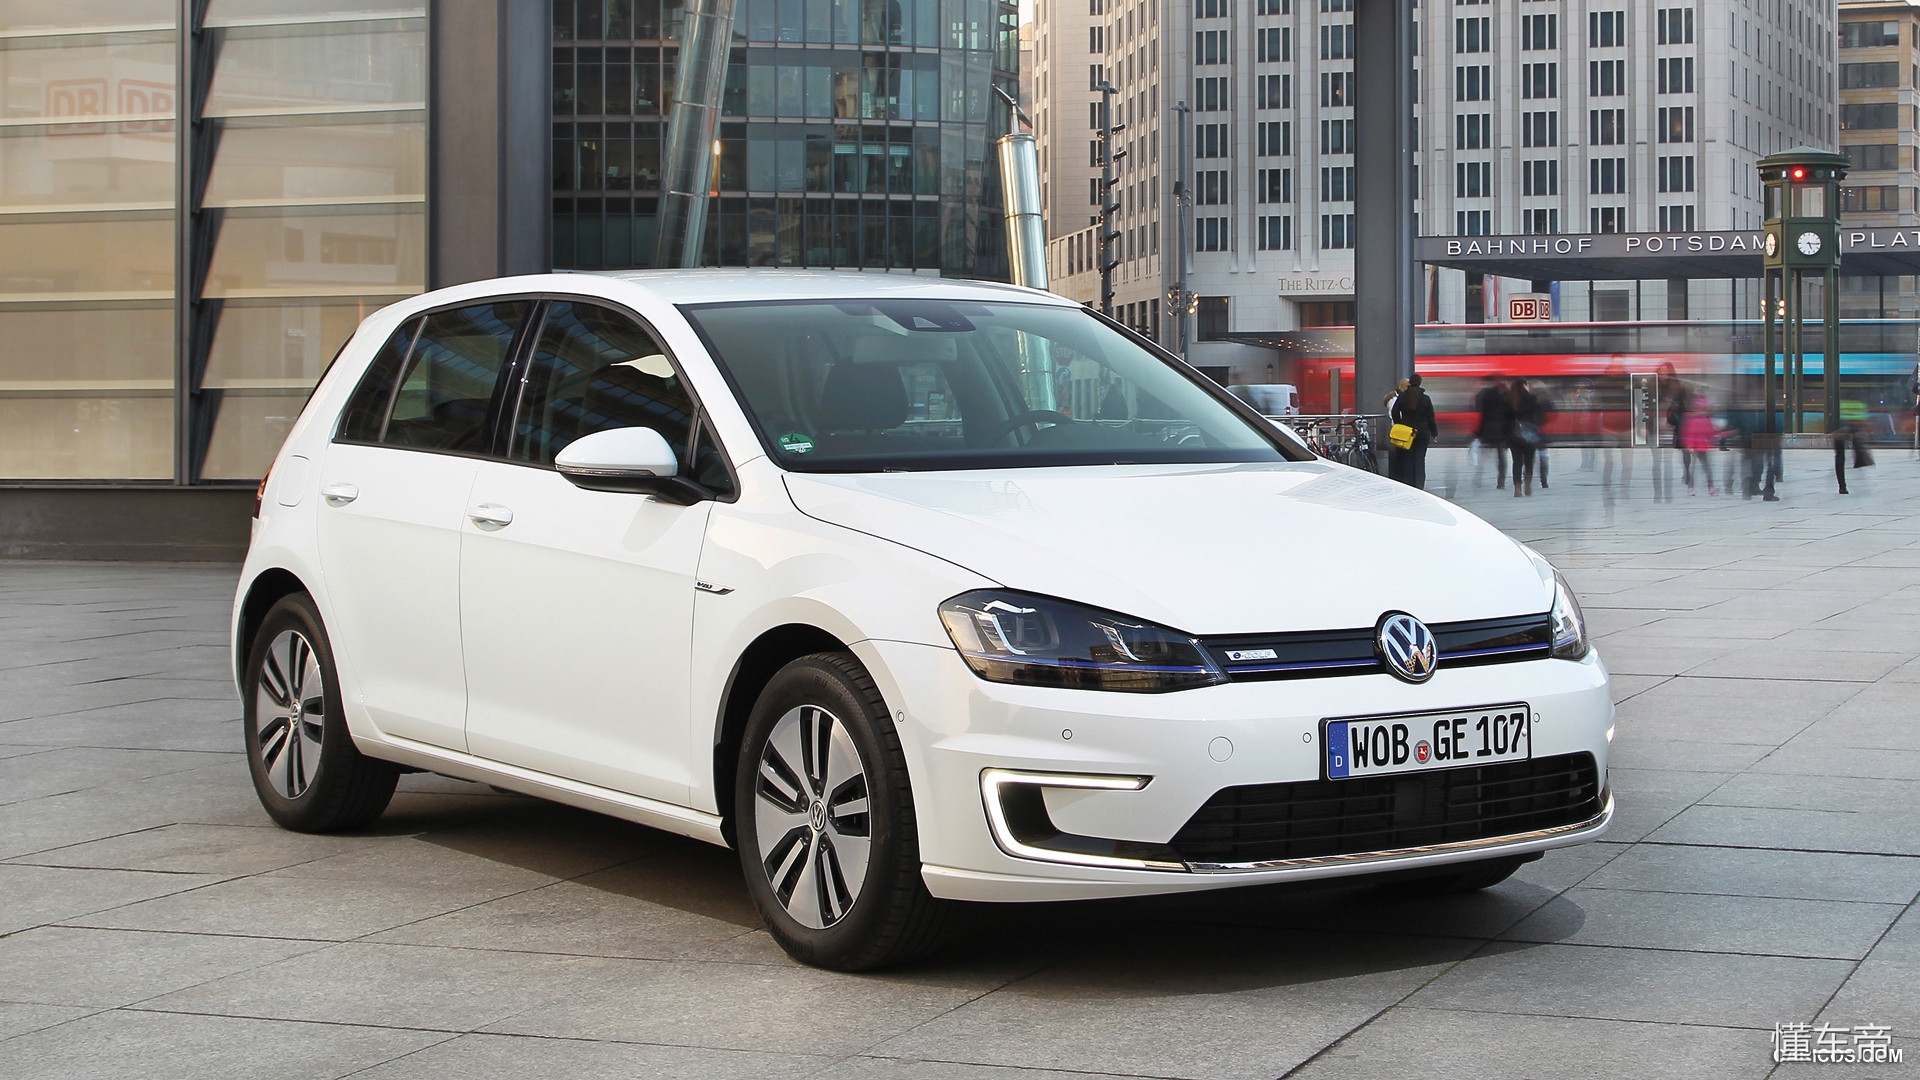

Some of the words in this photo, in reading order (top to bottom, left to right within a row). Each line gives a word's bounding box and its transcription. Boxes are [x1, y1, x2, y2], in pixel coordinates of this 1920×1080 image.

[53, 88, 99, 129] DB
[126, 89, 174, 131] DB
[1447, 238, 1592, 255] BAHNHOF
[1278, 278, 1302, 291] THE
[1513, 302, 1534, 317] DB
[1540, 302, 1550, 317] DB
[1383, 615, 1437, 680] VW
[1351, 723, 1410, 768] WOB
[1433, 718, 1469, 761] GE
[1476, 712, 1525, 758] 107
[1335, 755, 1342, 768] D
